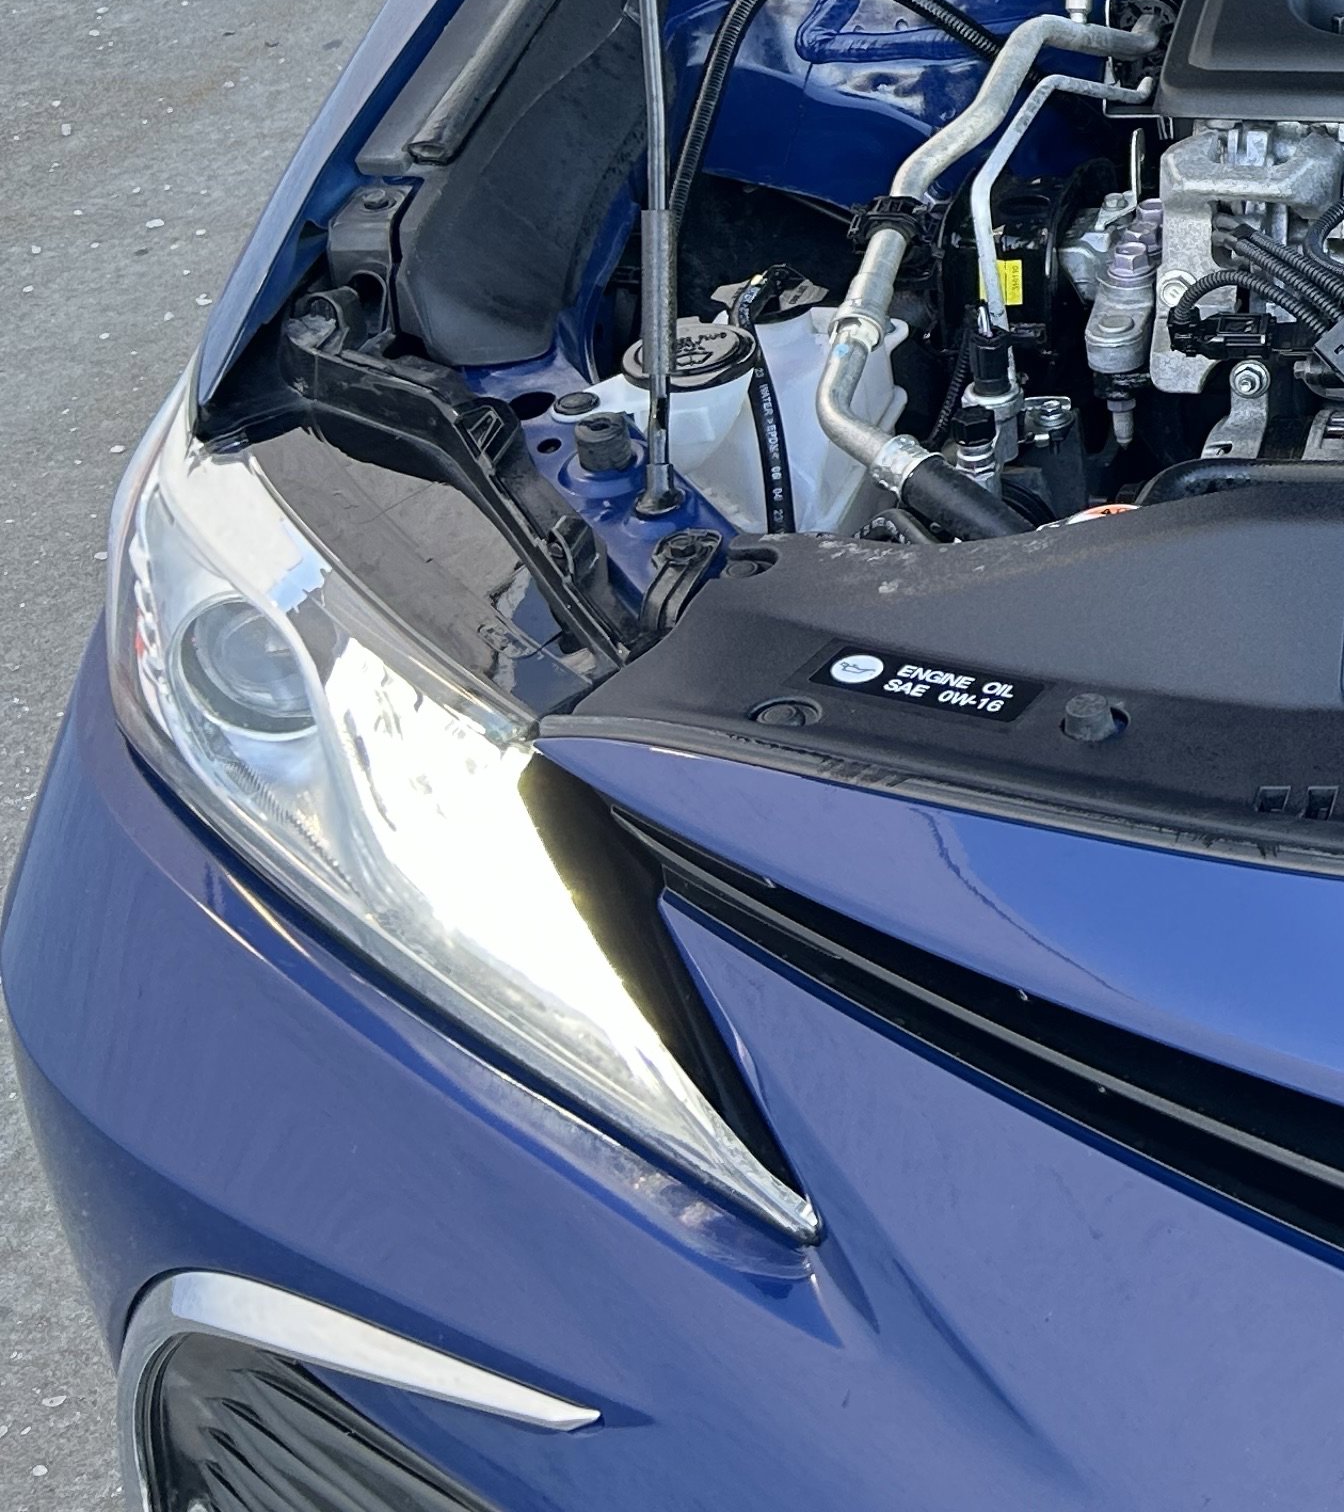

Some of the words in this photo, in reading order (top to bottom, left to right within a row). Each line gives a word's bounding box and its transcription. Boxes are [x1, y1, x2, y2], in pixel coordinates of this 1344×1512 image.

[759, 383, 774, 416] WATER
[883, 679, 930, 698] SAE
[938, 689, 1004, 712] 0W-16
[897, 664, 975, 689] ENGINE
[982, 681, 1014, 699] OIL
